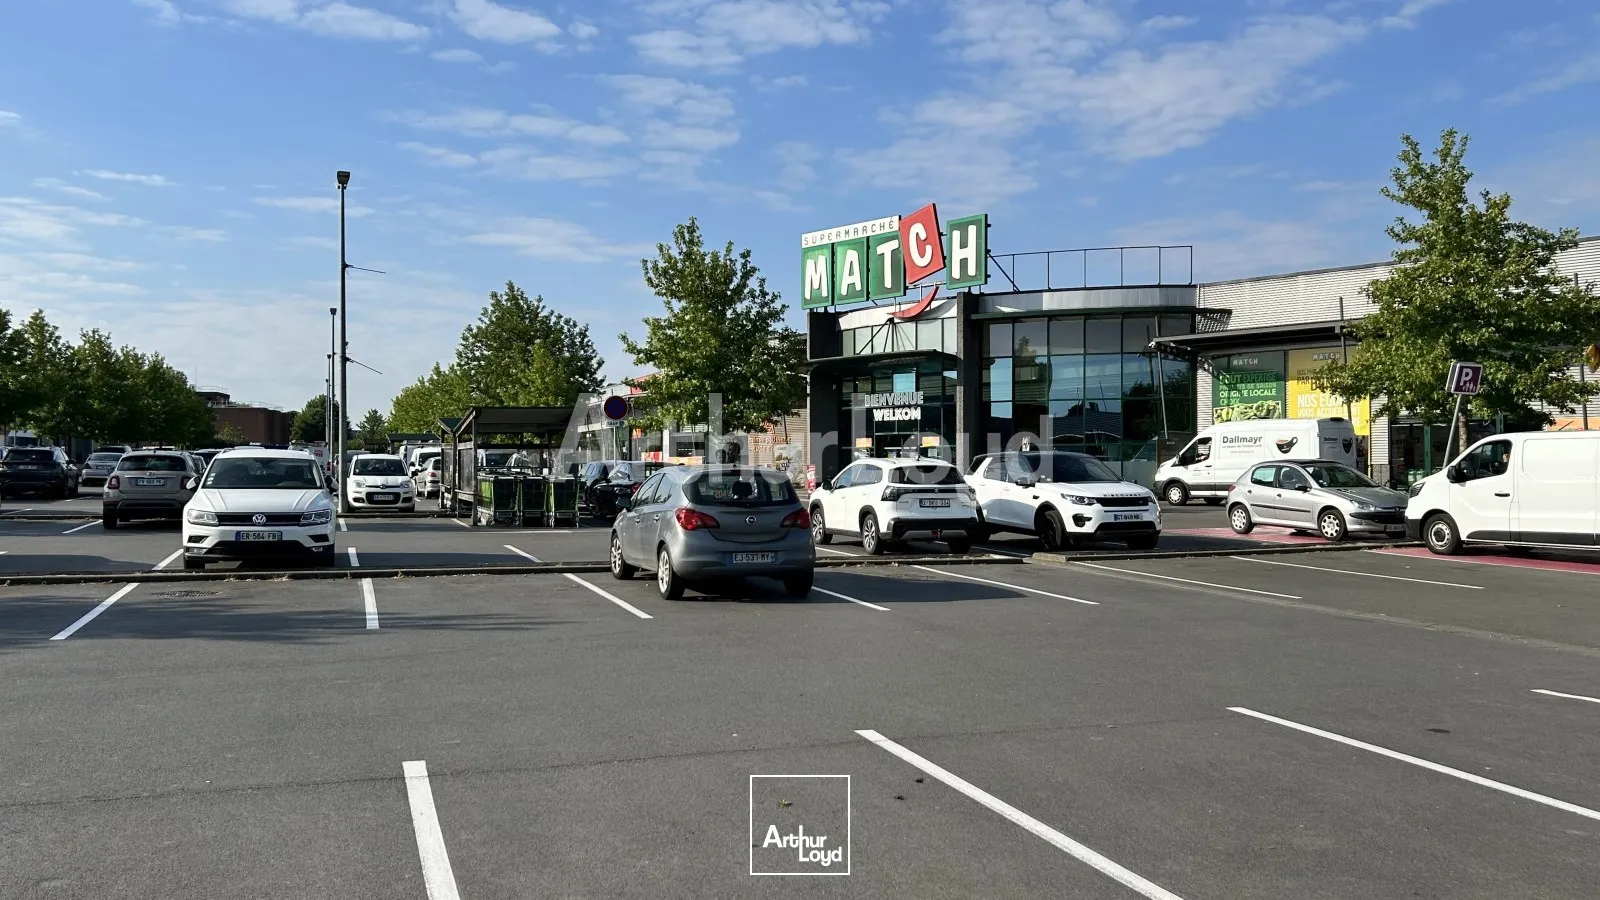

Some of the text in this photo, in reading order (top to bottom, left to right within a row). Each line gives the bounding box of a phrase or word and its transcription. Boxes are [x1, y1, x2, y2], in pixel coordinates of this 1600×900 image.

[803, 216, 895, 246] SUPERMARCHÉ
[804, 222, 977, 300] MATCH
[1232, 358, 1258, 366] MATCH
[1312, 352, 1340, 360] MATCH
[1249, 388, 1277, 396] LOCALE
[864, 391, 924, 407] BIENVENUE
[872, 406, 922, 421] WELKOM
[1222, 435, 1263, 444] Dallmayr
